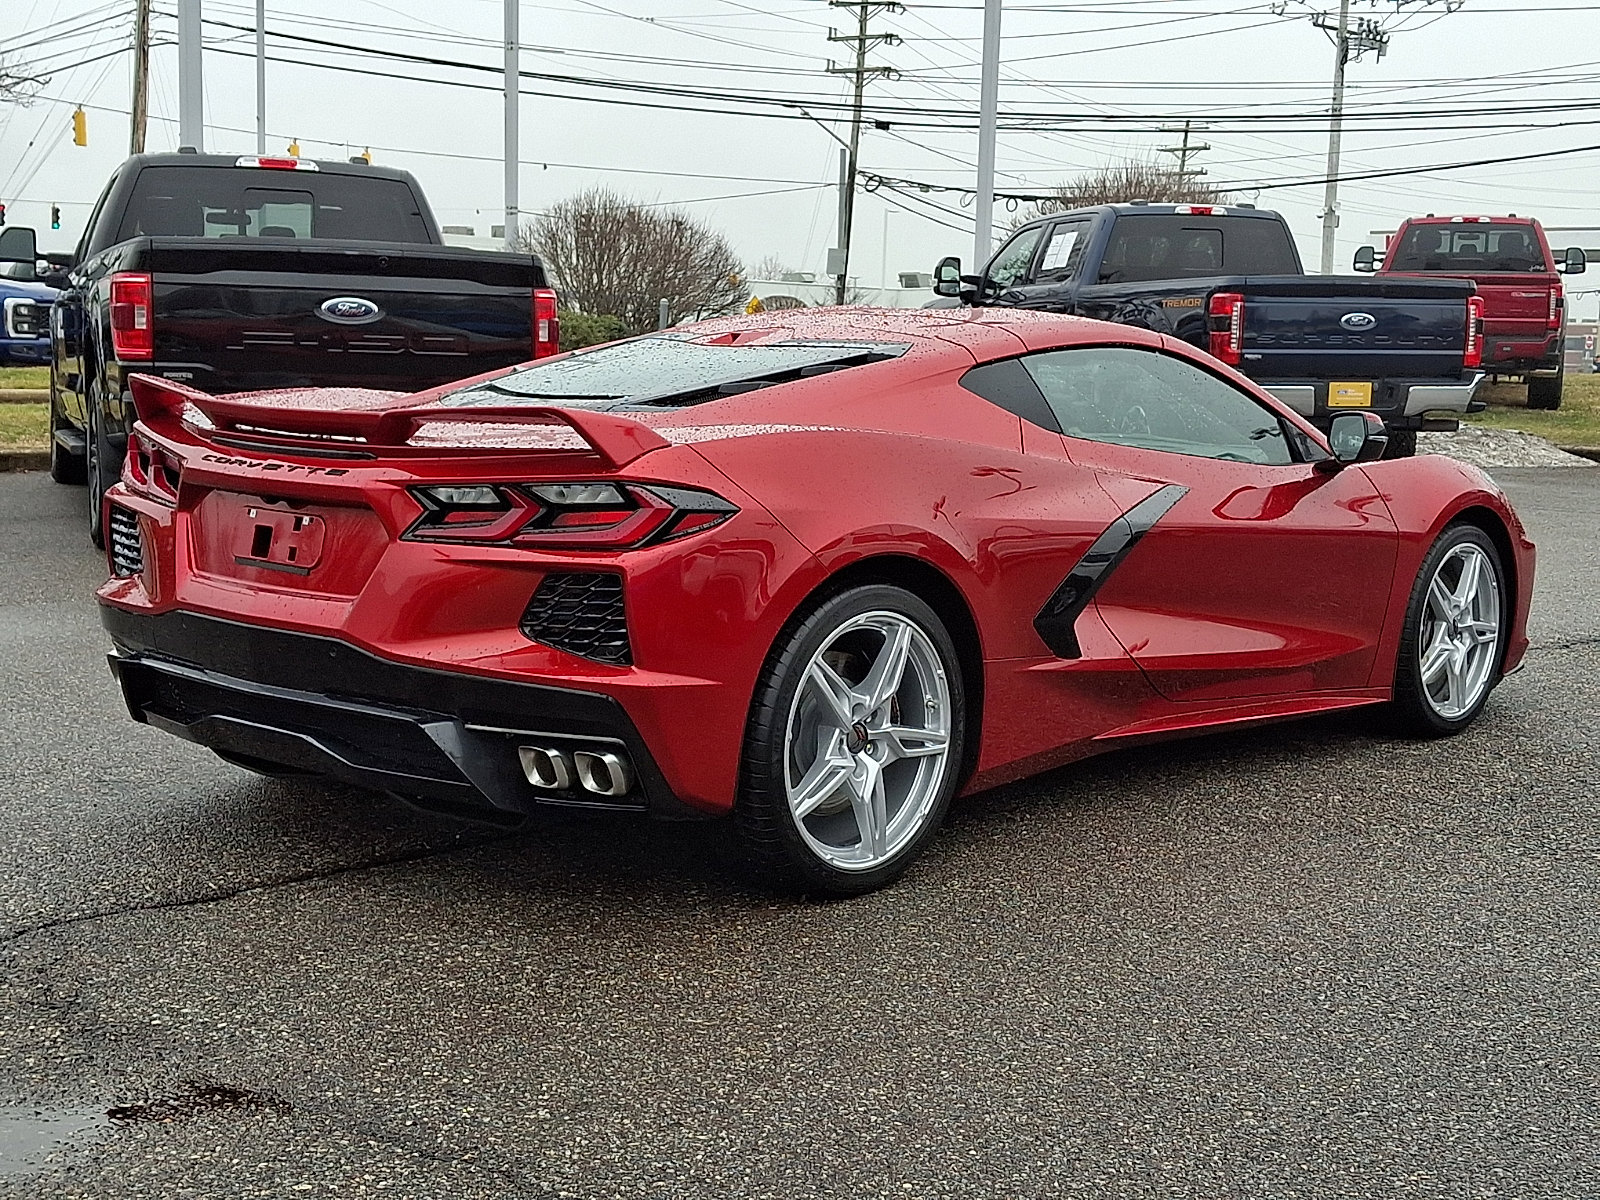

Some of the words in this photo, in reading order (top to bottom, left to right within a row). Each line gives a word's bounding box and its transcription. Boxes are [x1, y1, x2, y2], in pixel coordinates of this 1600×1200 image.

[335, 301, 367, 317] Ford
[1161, 298, 1202, 308] TREMOR
[1256, 334, 1365, 345] SUPER
[1374, 335, 1454, 346] DUTY
[201, 454, 350, 477] CORVETTE
